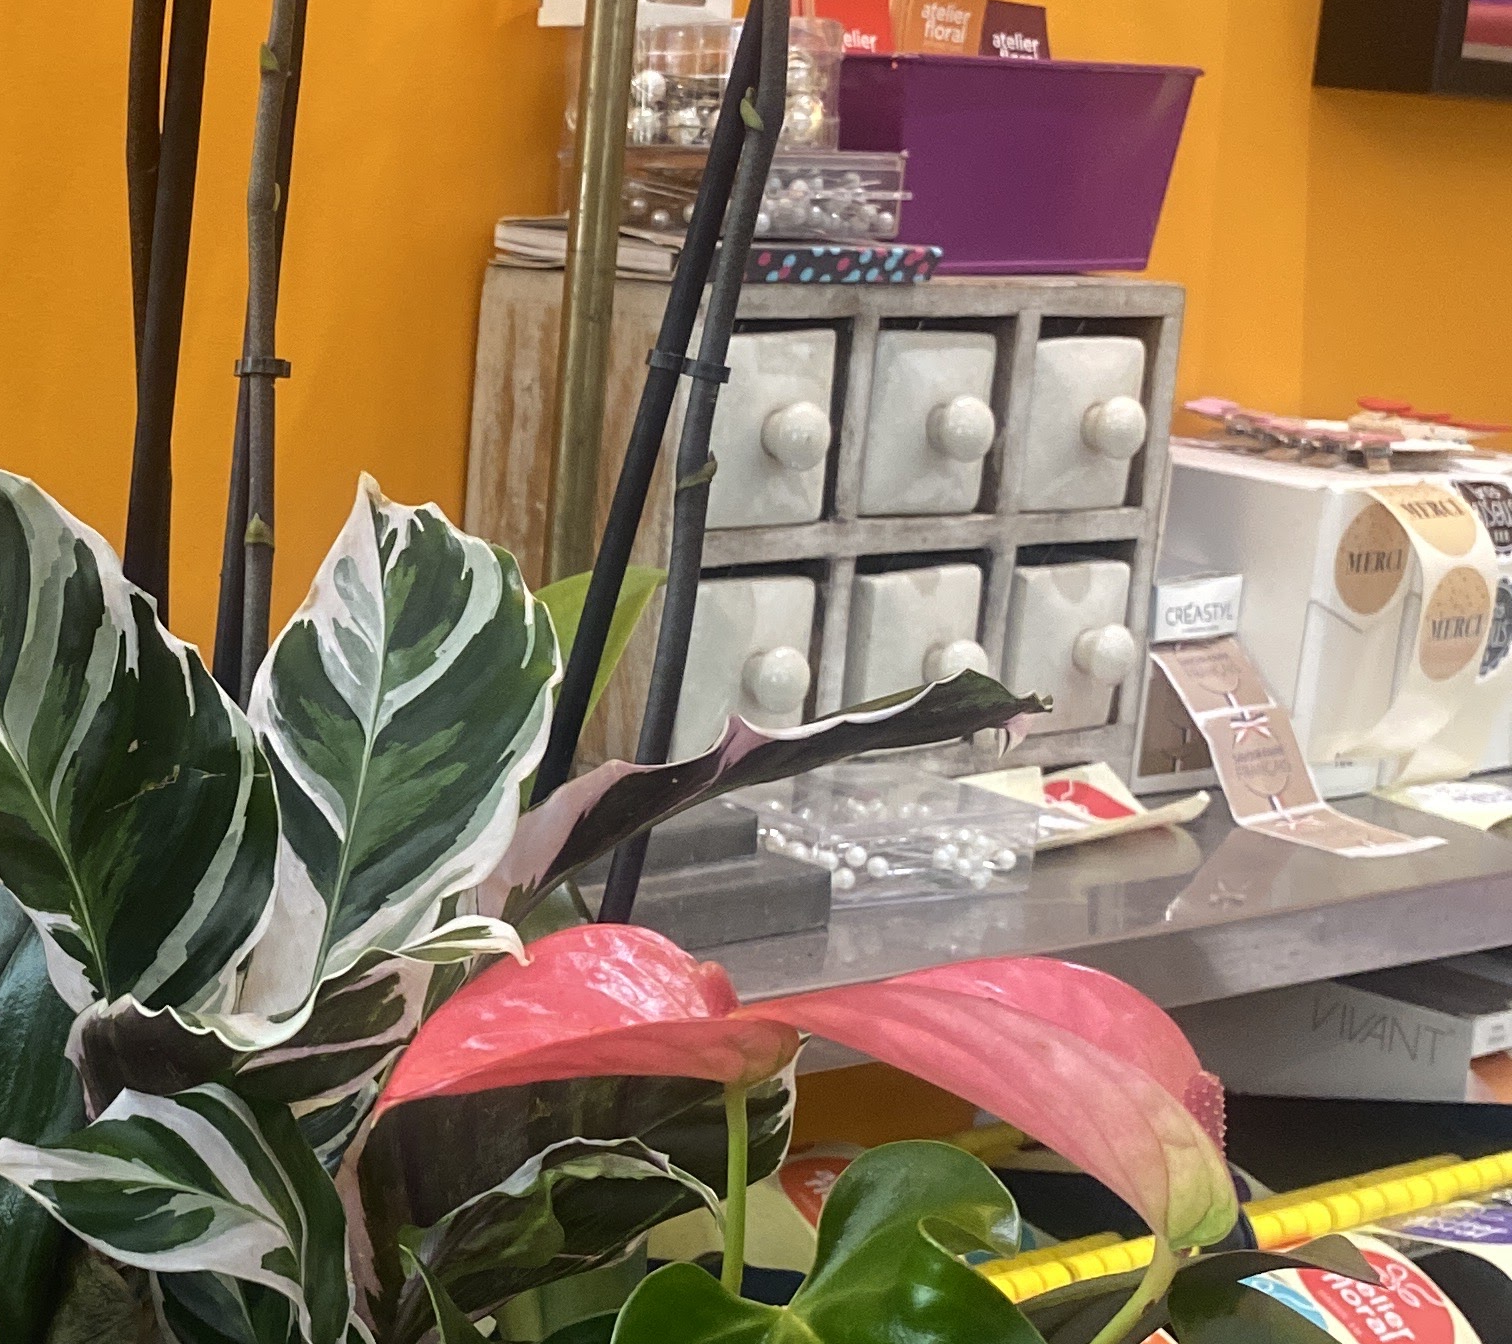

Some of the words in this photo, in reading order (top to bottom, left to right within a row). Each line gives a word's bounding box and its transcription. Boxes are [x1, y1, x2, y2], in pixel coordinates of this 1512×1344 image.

[921, 2, 970, 23] atelier
[841, 29, 878, 50] elier
[924, 20, 965, 43] floral
[992, 32, 1039, 54] atelier
[1401, 498, 1464, 519] MERCI
[1349, 549, 1403, 574] MERCI
[1431, 613, 1484, 640] MERCI
[1311, 997, 1445, 1066] VIVANT
